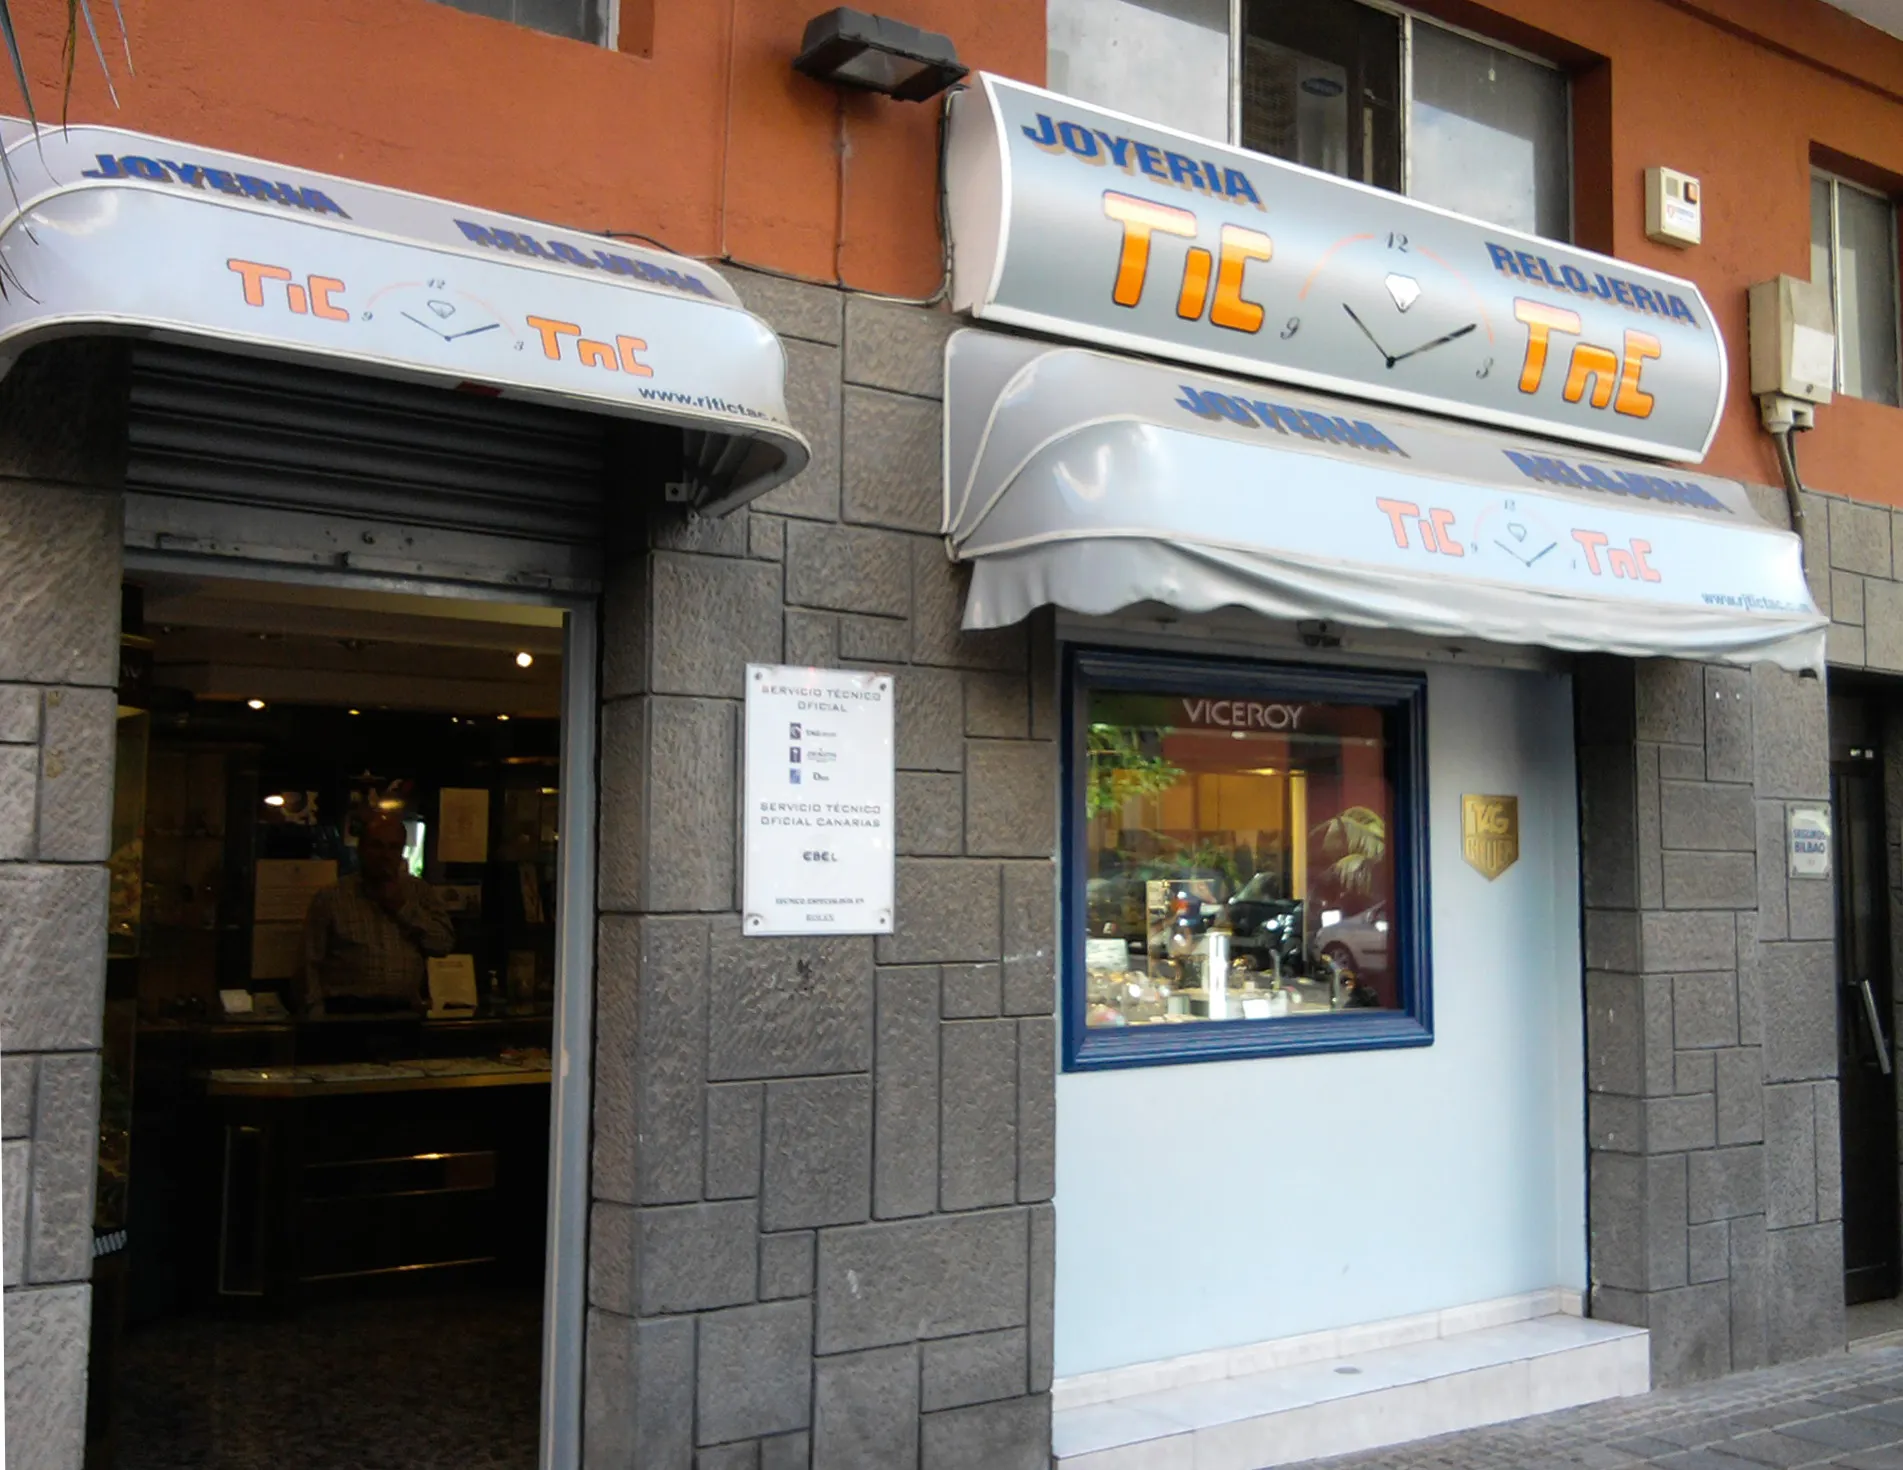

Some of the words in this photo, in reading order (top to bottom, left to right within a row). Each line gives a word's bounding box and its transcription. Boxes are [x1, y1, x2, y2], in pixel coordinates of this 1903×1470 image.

[81, 154, 352, 220] JOYERIA
[1021, 113, 1266, 211] JOYERIA
[1485, 242, 1701, 328] RELOJERIA
[1386, 231, 1409, 253] 12
[1280, 316, 1300, 340] 9
[1475, 357, 1494, 380] 3
[1174, 384, 1411, 458] JOYERIA
[761, 685, 822, 698] SERVICIO
[797, 700, 847, 712] OFICIAL
[1182, 698, 1303, 729] VICEROY
[760, 801, 821, 813] SERVICIO
[760, 816, 812, 827] OFICIAL
[816, 817, 881, 828] CANARIAS
[1794, 841, 1826, 854] BILBAO
